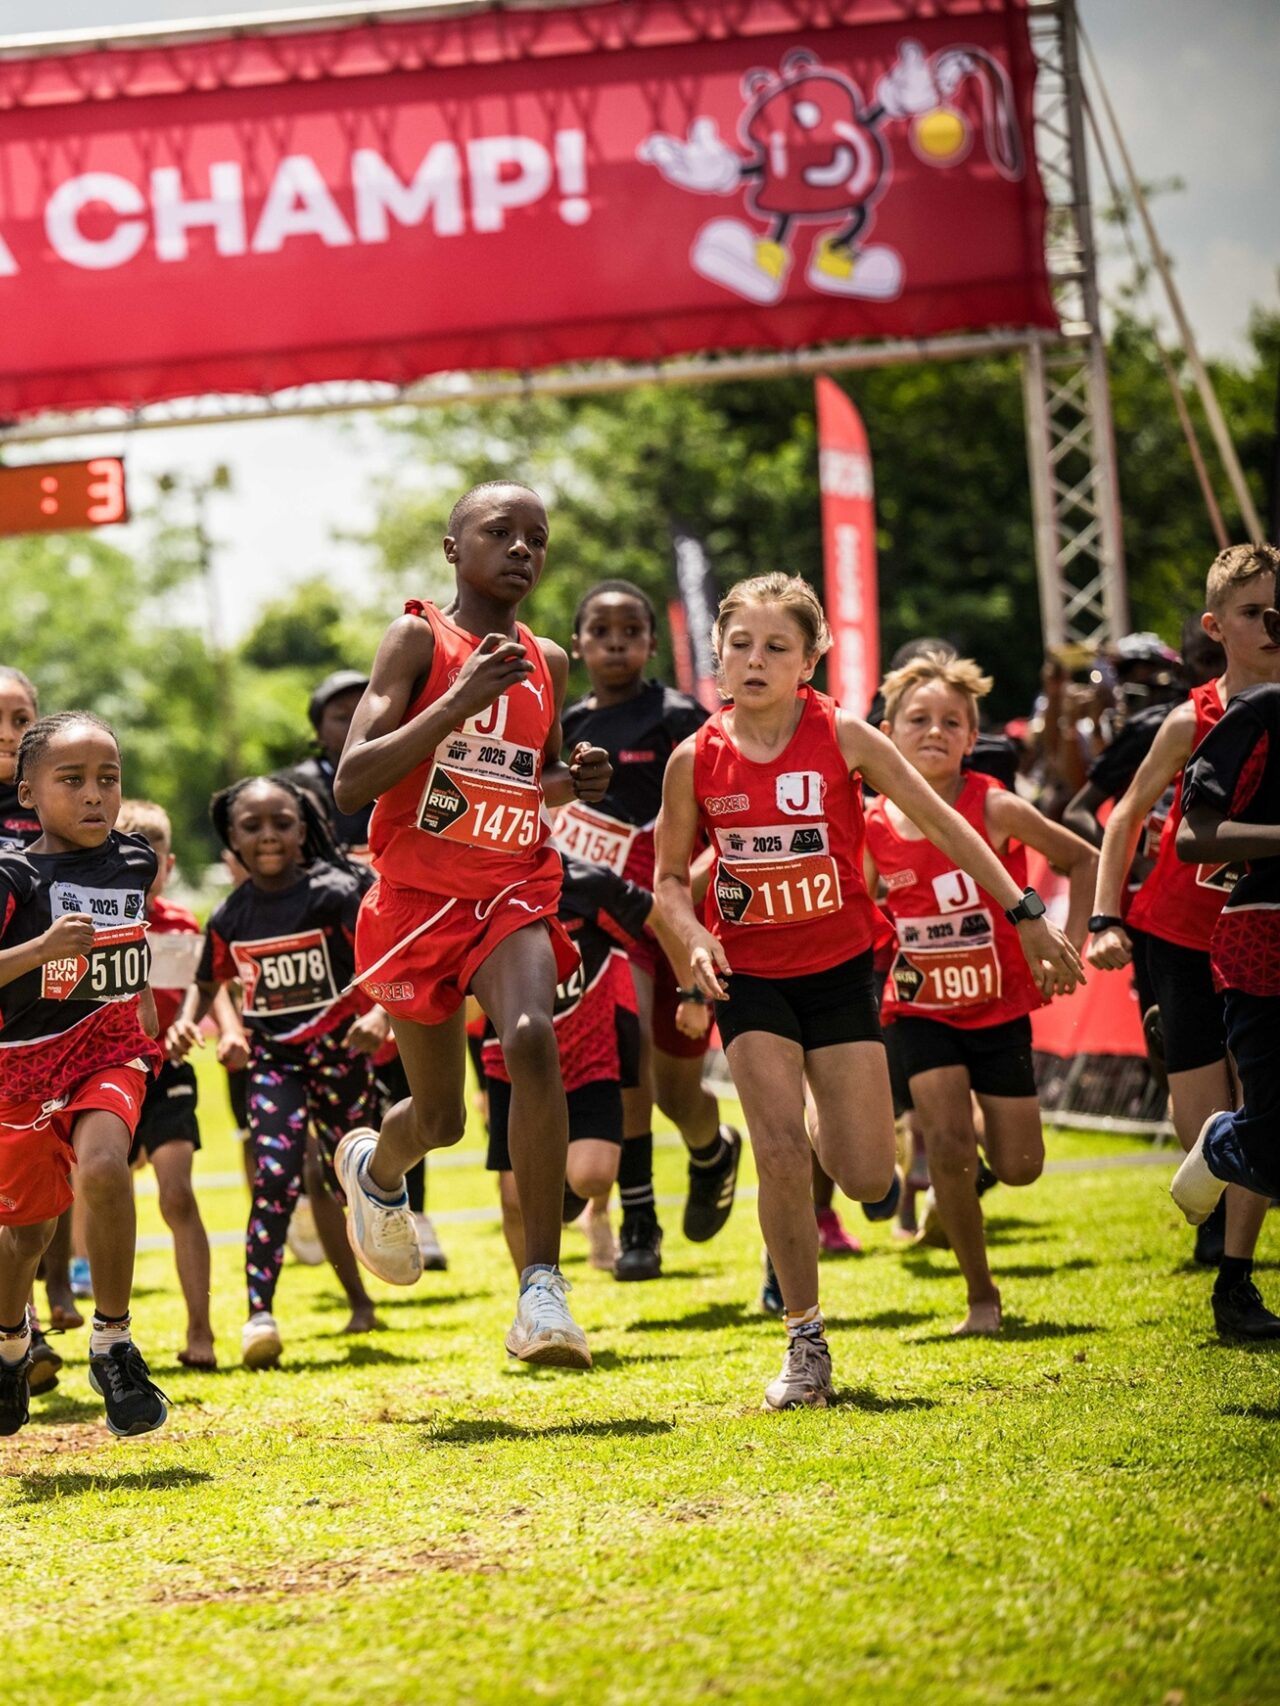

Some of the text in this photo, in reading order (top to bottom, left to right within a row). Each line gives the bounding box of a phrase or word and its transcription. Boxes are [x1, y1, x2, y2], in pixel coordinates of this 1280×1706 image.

[44, 127, 592, 270] CHAMP!
[475, 697, 500, 734] J
[447, 749, 468, 761] AVT
[477, 746, 507, 766] 2025
[516, 750, 532, 766] ASA
[428, 794, 459, 812] RUN
[785, 775, 810, 811] J
[472, 801, 535, 846] 1475
[566, 826, 622, 867] 4154
[752, 836, 782, 853] 2025
[793, 831, 820, 844] ASA
[63, 891, 78, 900] ASA
[89, 898, 119, 916] 2025
[718, 885, 744, 900] RUN
[758, 873, 834, 916] 1112
[948, 873, 969, 906] J
[62, 900, 82, 913] CGA
[926, 923, 954, 940] 2025
[47, 957, 78, 972] RUN
[47, 970, 77, 982] 1KM
[91, 944, 148, 991] 5101
[262, 949, 326, 989] 5078
[928, 963, 992, 999] 1901
